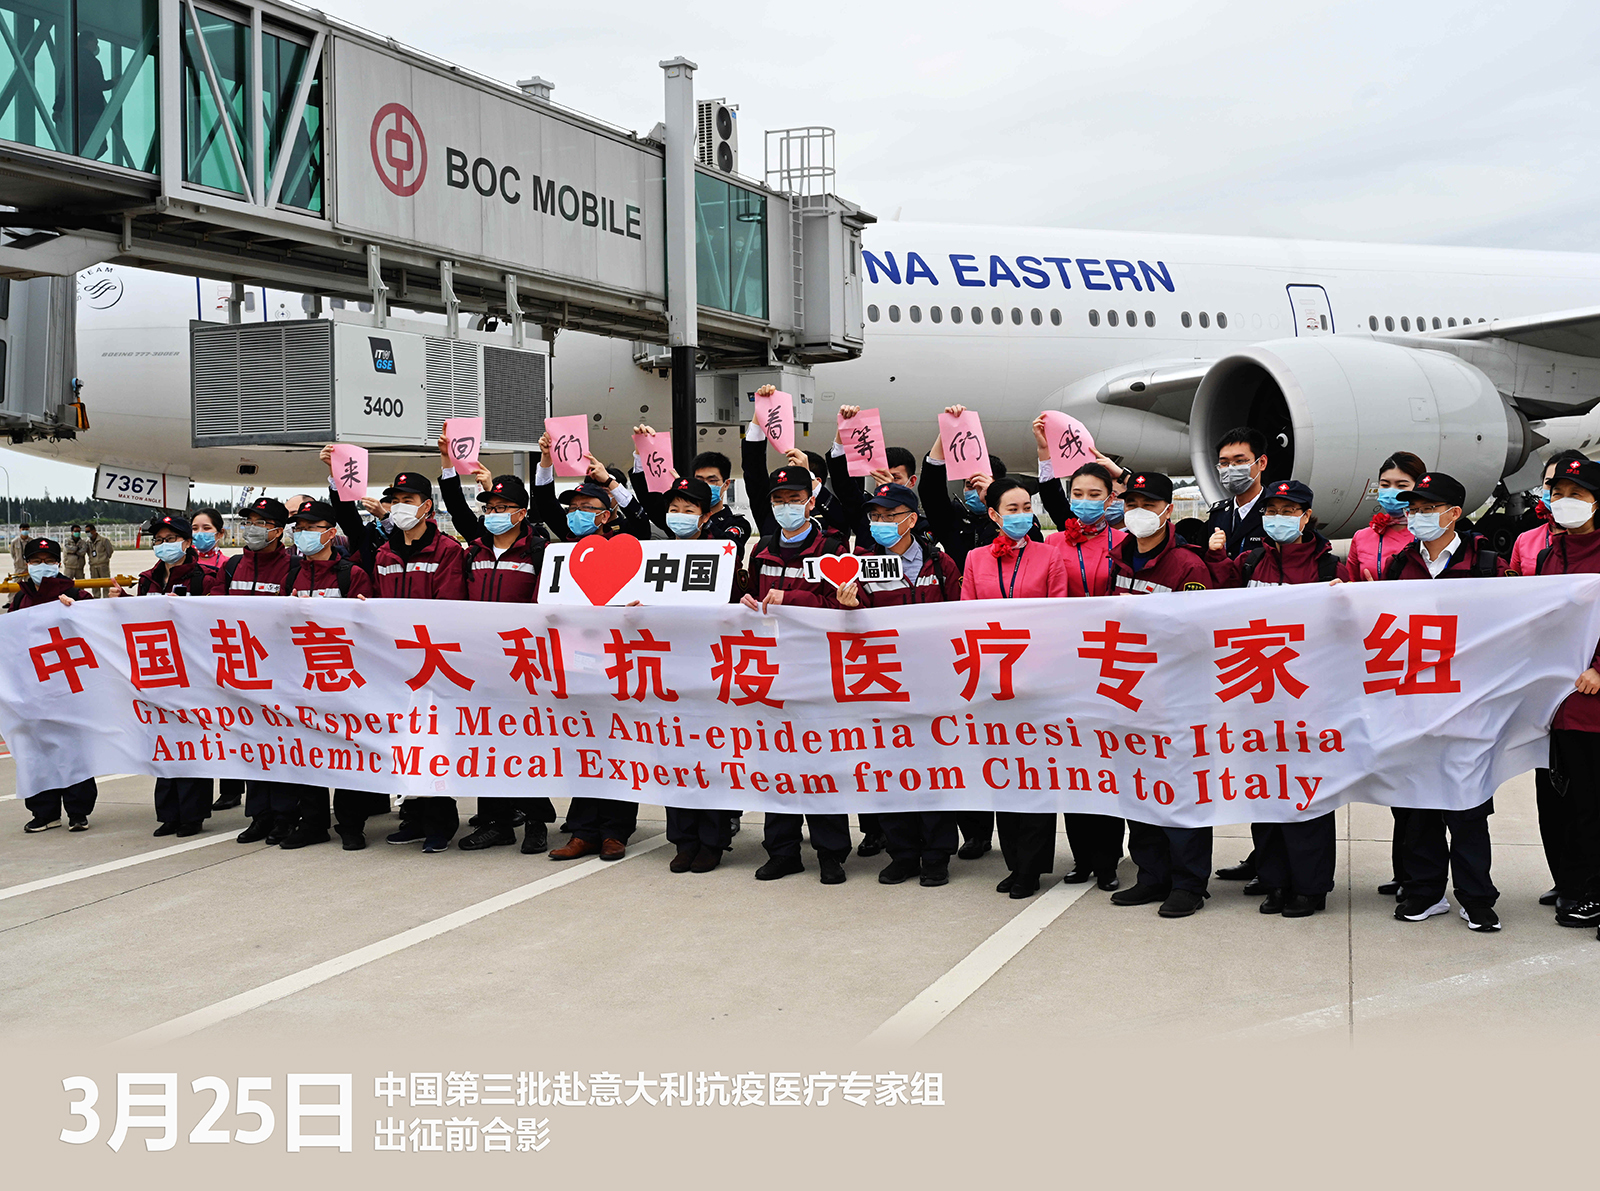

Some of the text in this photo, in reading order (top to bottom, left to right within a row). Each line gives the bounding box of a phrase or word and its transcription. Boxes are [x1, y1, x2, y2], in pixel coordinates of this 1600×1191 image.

[446, 146, 643, 241] BOC MOBILE
[862, 250, 1176, 293] NA EASTERN
[376, 359, 394, 370] GSE
[363, 395, 404, 418] 3400
[450, 436, 476, 460] 回
[553, 434, 583, 463] 们
[850, 425, 875, 463] 等
[949, 430, 983, 463] 们
[1058, 423, 1087, 460] 我
[340, 457, 361, 489] 来
[646, 451, 667, 478] 你
[105, 472, 159, 496] 7367
[548, 552, 721, 594] I 中国
[802, 555, 902, 581] I 福州
[28, 612, 1461, 713] 中国赴意大利抗疫医疗专家组
[133, 700, 1345, 759] Gruppo di Esperti Medici Anti-epidemia Cinesi per Italia
[152, 733, 1322, 811] Anti-epidemic Medical Expert Team from China to Italy
